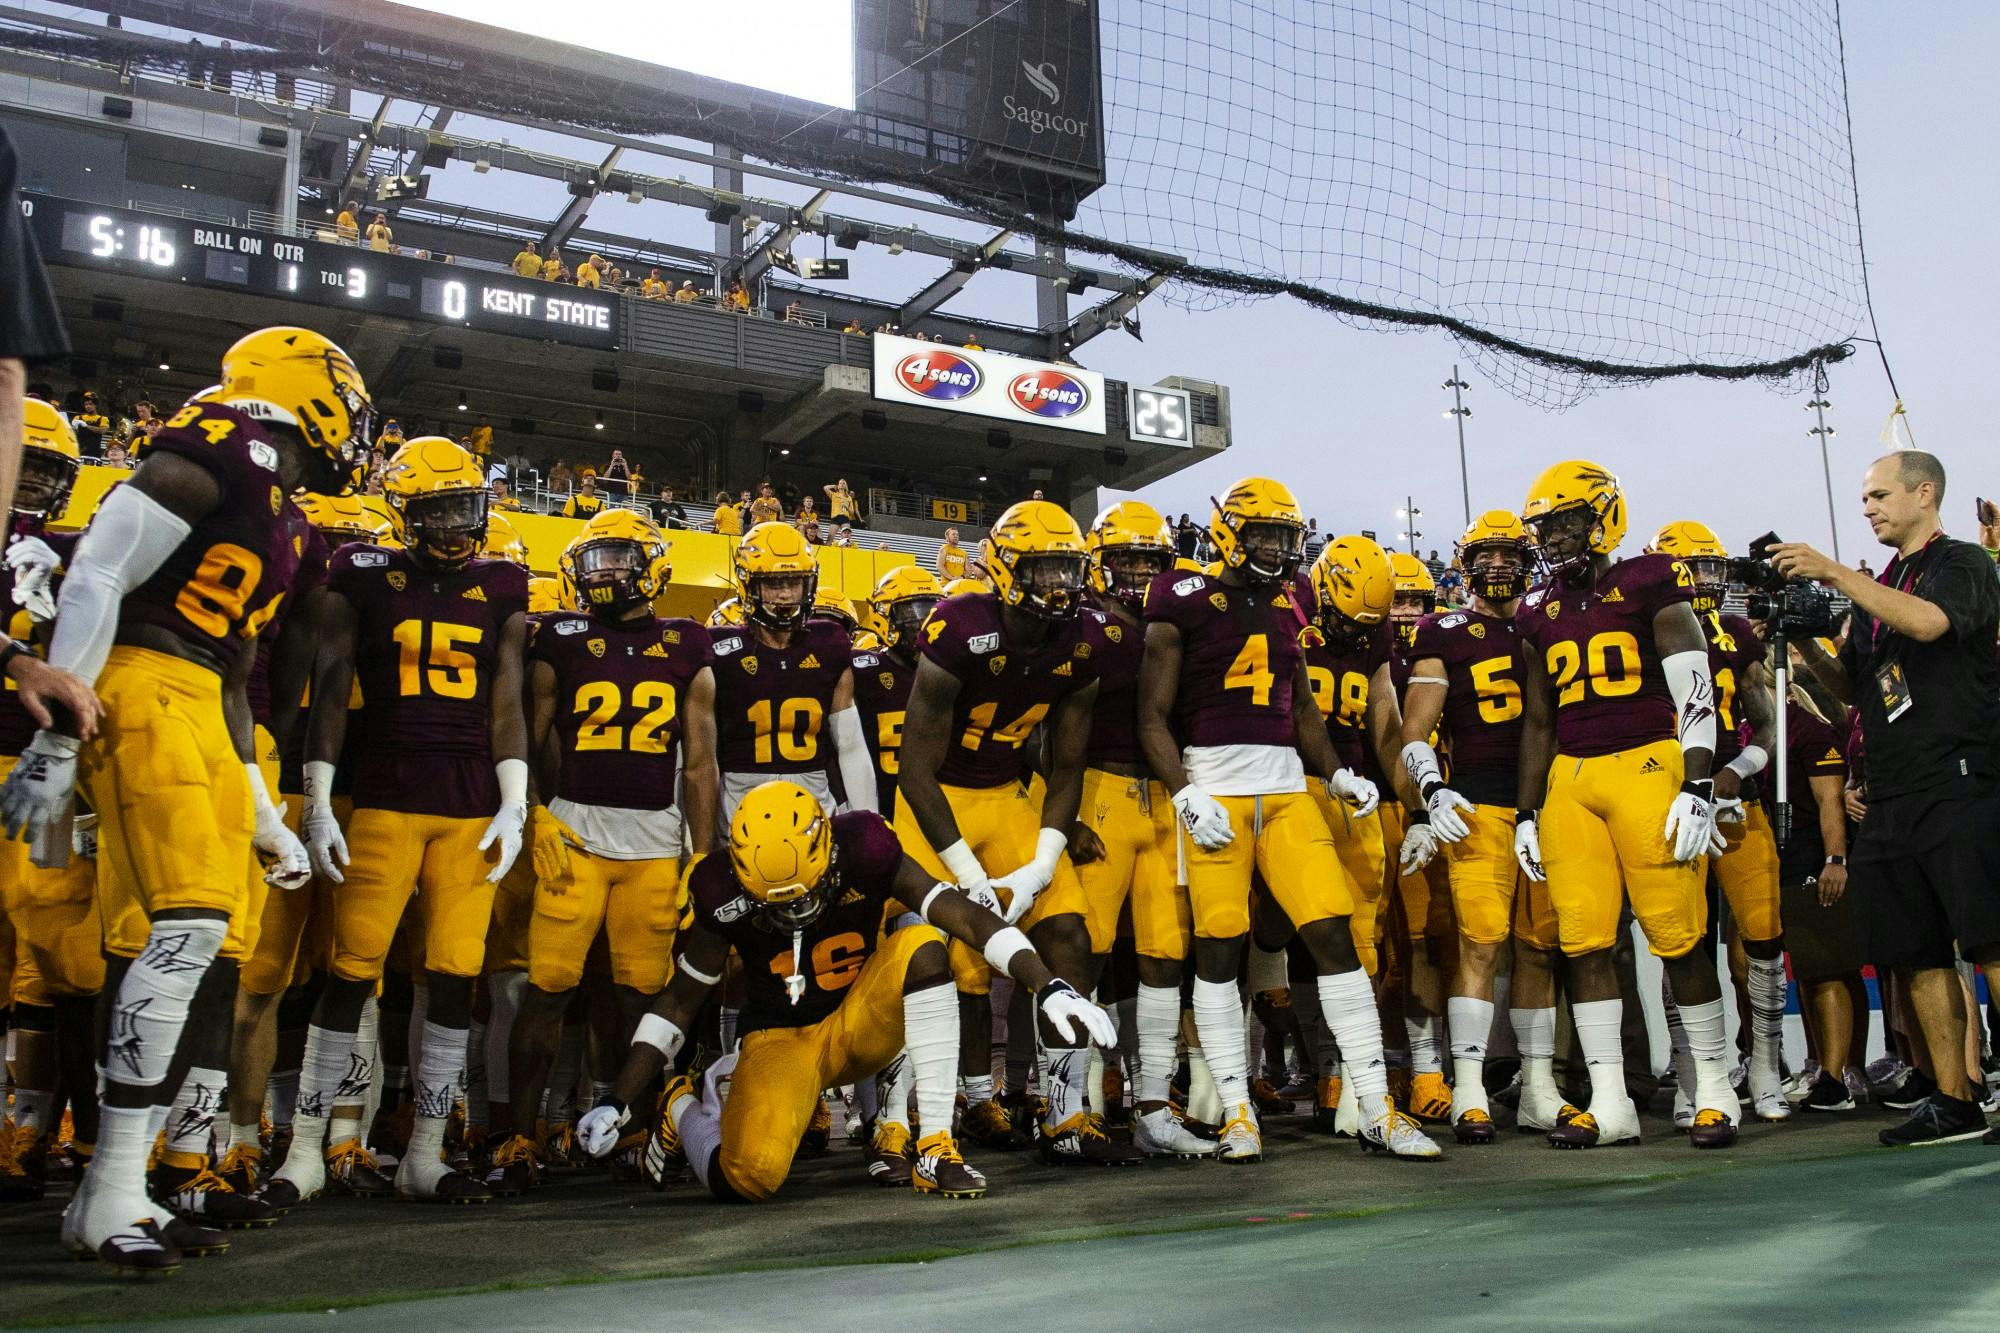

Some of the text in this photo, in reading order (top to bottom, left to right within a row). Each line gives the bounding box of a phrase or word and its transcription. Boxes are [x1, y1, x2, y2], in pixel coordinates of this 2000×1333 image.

[1003, 95, 1089, 138] Sagicor
[90, 215, 175, 267] 5:16
[194, 229, 262, 255] BALL ON
[273, 243, 304, 263] QTR
[287, 265, 298, 291] 1
[320, 270, 345, 287] TOL
[348, 268, 366, 298] 3
[443, 280, 466, 319] 0
[483, 288, 610, 329] KENT STATE
[905, 359, 972, 387] 4 SONS
[1016, 378, 1079, 405] 4 SONS
[166, 406, 236, 445] 84
[1136, 393, 1183, 438] 25
[942, 504, 958, 519] 19
[393, 619, 484, 699] 15
[1224, 634, 1275, 706] 4
[1548, 631, 1642, 708] 20
[1470, 656, 1523, 724] 5
[573, 681, 676, 753] 22
[747, 697, 823, 763] 10
[961, 702, 1050, 751] 14
[1639, 765, 1666, 776] adidas
[769, 932, 866, 996] 16
